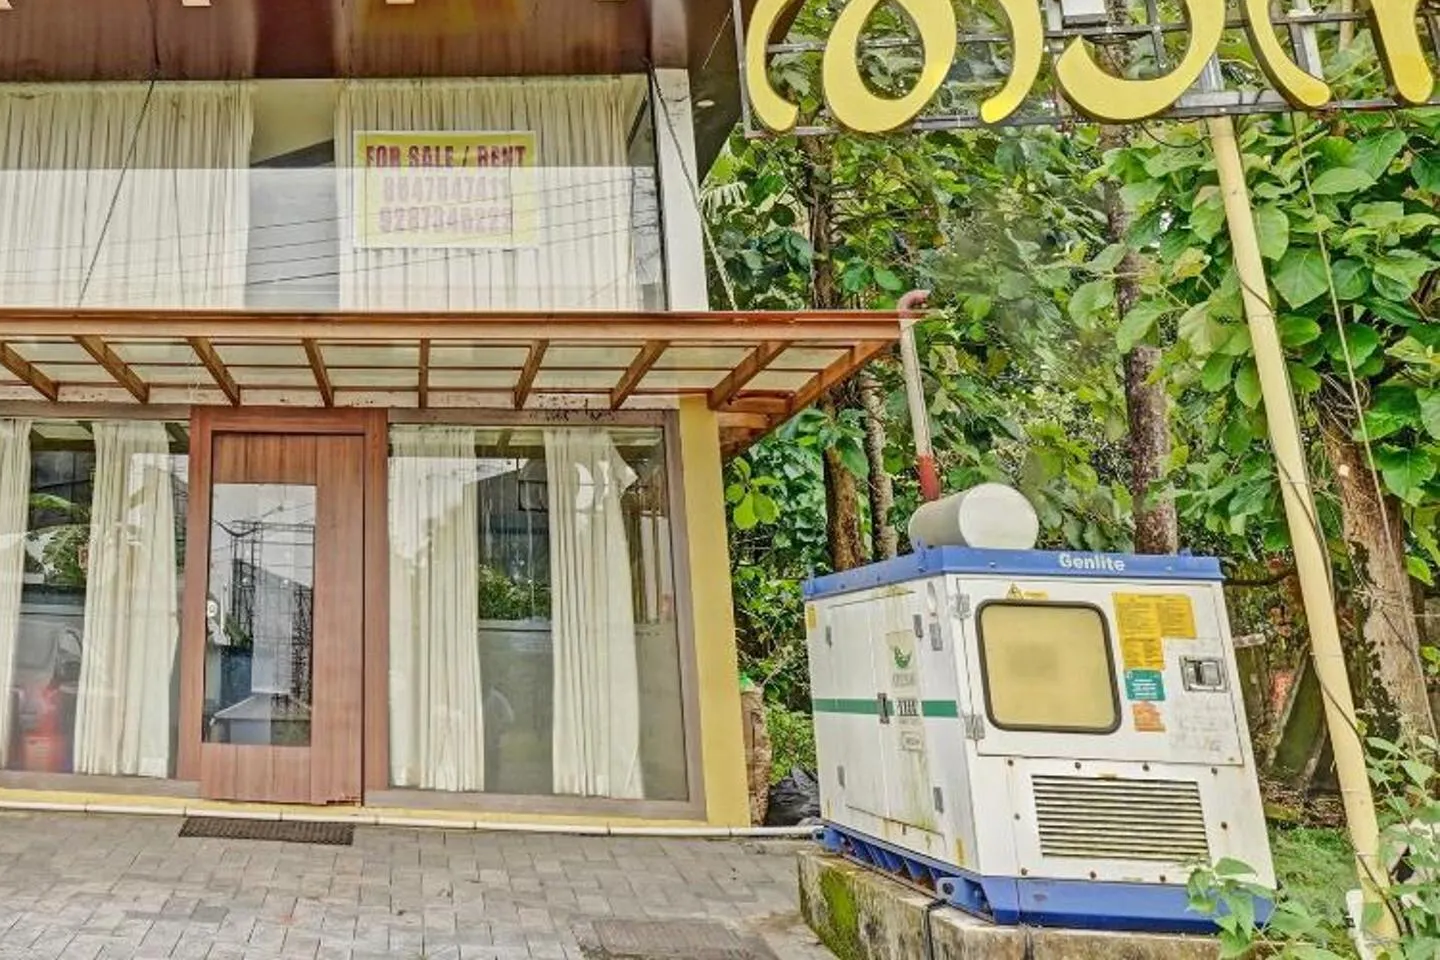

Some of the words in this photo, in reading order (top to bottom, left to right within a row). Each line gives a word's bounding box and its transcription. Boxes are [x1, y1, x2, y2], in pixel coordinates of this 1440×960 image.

[366, 145, 401, 168] FOR
[409, 145, 454, 168] SALE
[478, 145, 526, 168] RENT
[1060, 553, 1125, 572] Genlite
